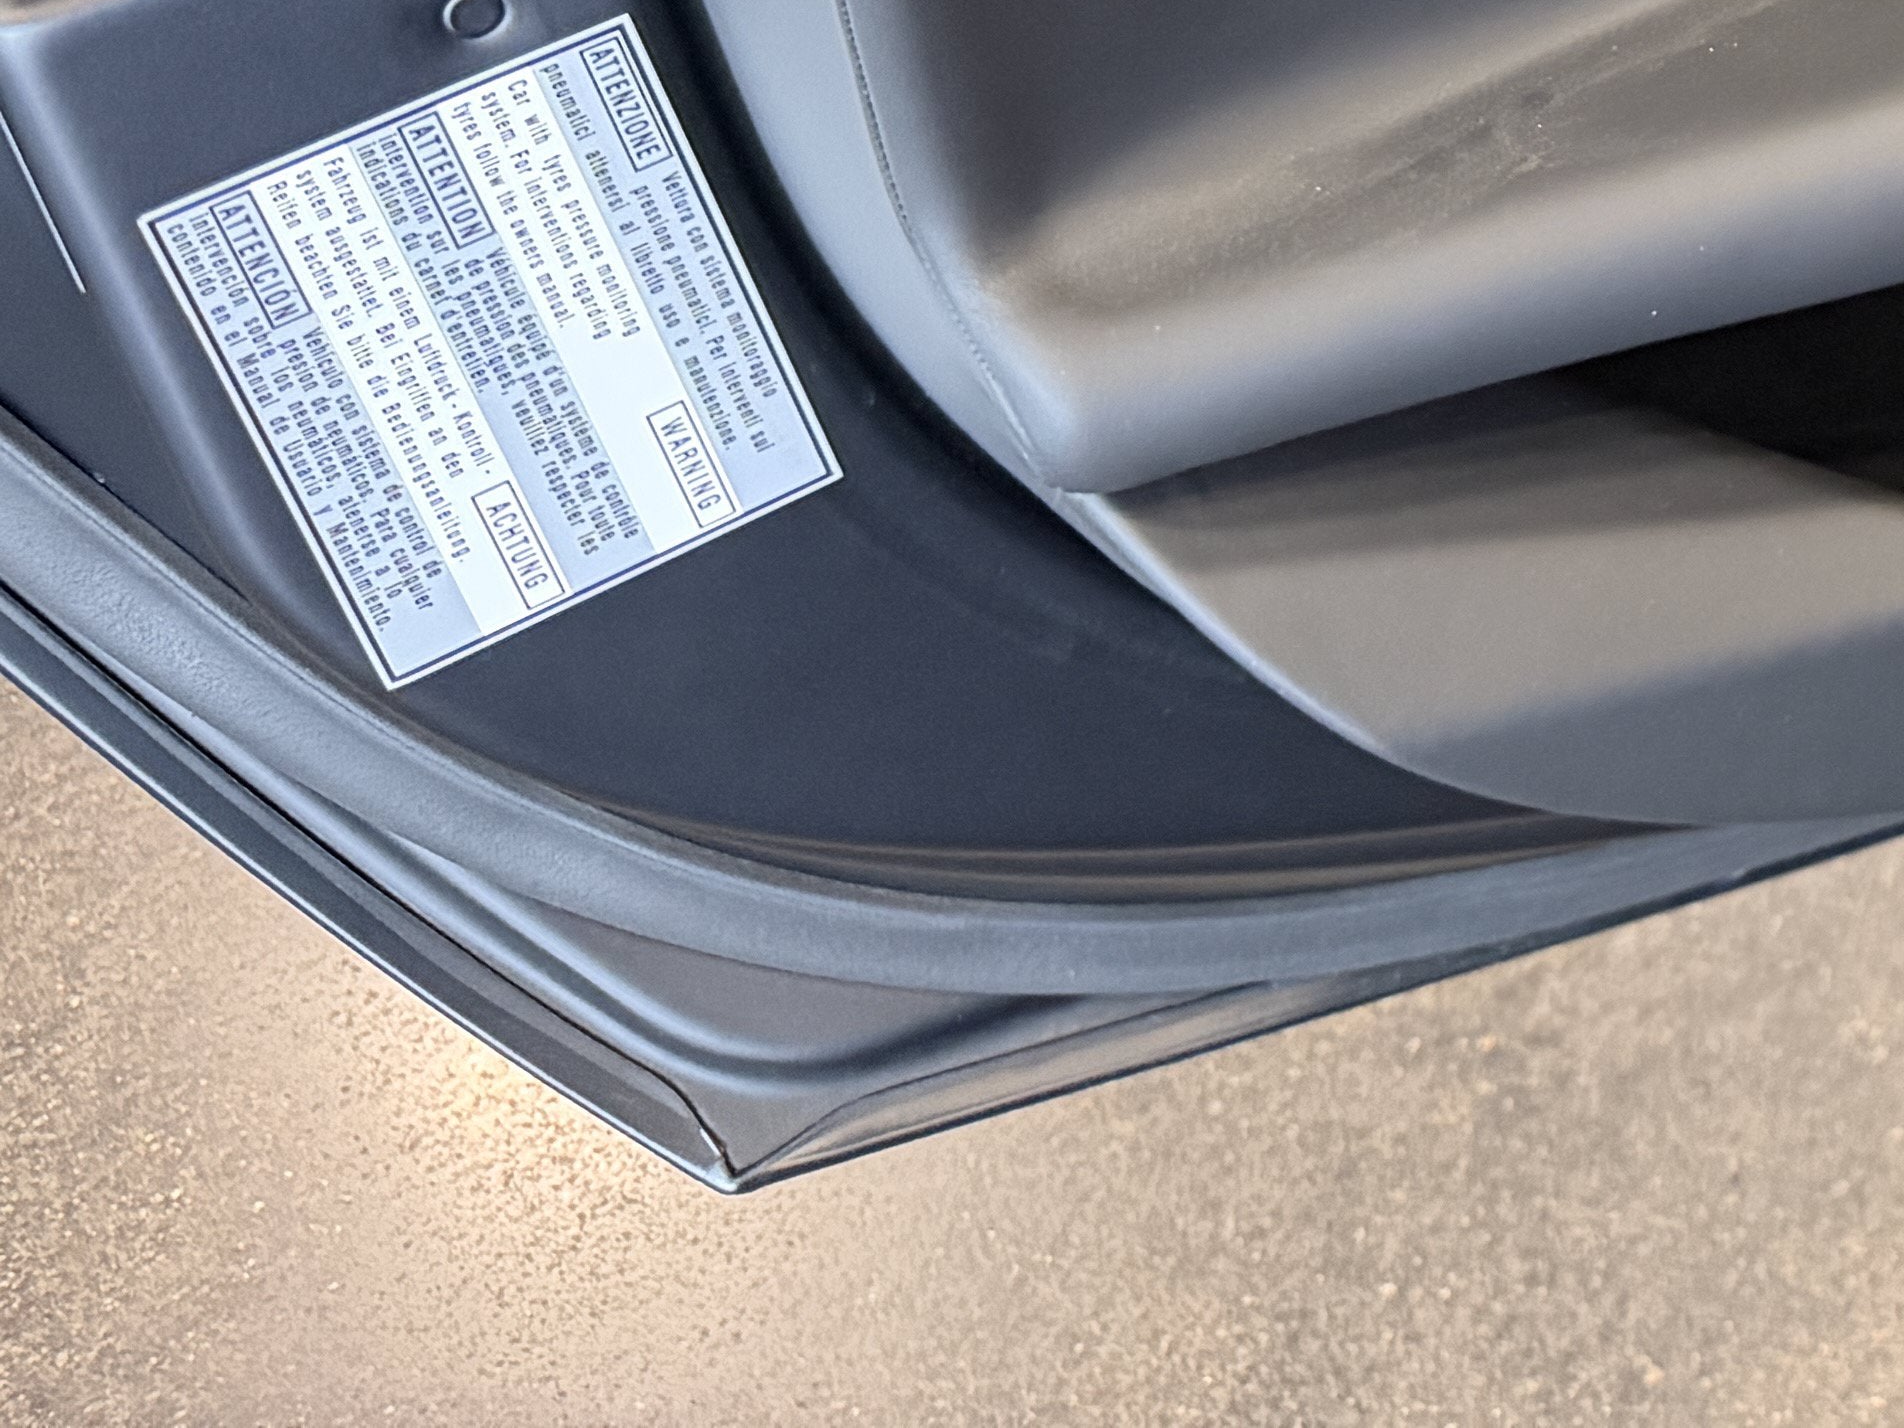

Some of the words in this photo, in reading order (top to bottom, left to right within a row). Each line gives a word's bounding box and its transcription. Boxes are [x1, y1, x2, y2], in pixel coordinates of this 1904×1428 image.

[537, 61, 597, 142] pneumatici
[587, 46, 663, 162] ATTENZIONE
[294, 168, 334, 222] system
[321, 155, 368, 225] Fahrzeug
[406, 122, 487, 241] ATTENTION
[506, 77, 532, 106] Car
[522, 112, 553, 146] with
[540, 152, 572, 193] tyres
[559, 198, 605, 261] pressure
[594, 262, 641, 338] monitoring
[583, 148, 631, 214] attenersi
[354, 139, 410, 227] indications
[399, 230, 423, 253] du
[412, 255, 454, 307] carnet
[358, 225, 385, 251] ist
[449, 100, 483, 142] tyres
[471, 141, 506, 188] follow
[494, 188, 519, 216] the
[508, 217, 545, 270] owners
[534, 271, 576, 329] manual.
[479, 90, 517, 149] system.
[508, 147, 533, 175] For
[522, 174, 579, 270] interventions
[567, 271, 612, 341] regarding
[617, 219, 642, 237] al
[164, 221, 219, 298] contenido
[216, 196, 306, 322] ATTENCIÓN
[371, 254, 400, 283] mit
[462, 257, 486, 278] de
[628, 240, 667, 295] libretto
[659, 168, 696, 224] Vettura
[684, 224, 710, 254] con
[698, 253, 737, 310] sistema
[724, 309, 779, 399] monitoraggio
[208, 303, 232, 326] en
[265, 178, 302, 230] Reifen
[292, 231, 339, 301] beachten
[329, 302, 356, 331] Sie
[344, 331, 375, 370] bitte
[365, 373, 391, 399] die
[387, 285, 421, 331] einem
[469, 278, 523, 346] pression
[657, 301, 682, 329] uso
[222, 328, 249, 348] el
[241, 314, 281, 360] sobre
[373, 320, 404, 349] Bei
[376, 130, 435, 225] intervention
[424, 228, 451, 256] sur
[439, 257, 465, 286] les
[509, 397, 553, 457] veuillez
[539, 458, 587, 527] respecter
[575, 528, 600, 557] les
[627, 183, 676, 253] pressione
[660, 253, 718, 336] pneumatici.
[703, 333, 729, 361] Per
[716, 359, 765, 429] interventi
[748, 428, 776, 454] sui
[673, 335, 691, 348] e
[234, 350, 282, 411] Manual
[268, 363, 295, 393] los
[504, 341, 531, 370] des
[333, 391, 361, 422] con
[388, 350, 436, 423] Eingriffen
[681, 353, 737, 452] manutenzione.
[267, 414, 292, 436] de
[426, 425, 448, 447] an
[514, 369, 578, 471] pneumatiques.
[349, 423, 396, 481] sistema
[439, 450, 465, 479] den
[588, 459, 611, 481] de
[659, 414, 722, 511] WARNING
[308, 394, 333, 416] de
[367, 505, 399, 544] Para
[387, 546, 435, 611] cualquier
[311, 502, 334, 517] y
[380, 482, 408, 504] de
[568, 468, 599, 504] Pour
[336, 493, 385, 558] atenerse
[392, 505, 436, 557] control
[484, 500, 549, 591] ACHTUNG
[586, 503, 616, 542] toute
[324, 519, 392, 633] Mantenimiento.
[372, 563, 392, 578] a
[381, 579, 407, 600] lo
[420, 558, 444, 579] de
